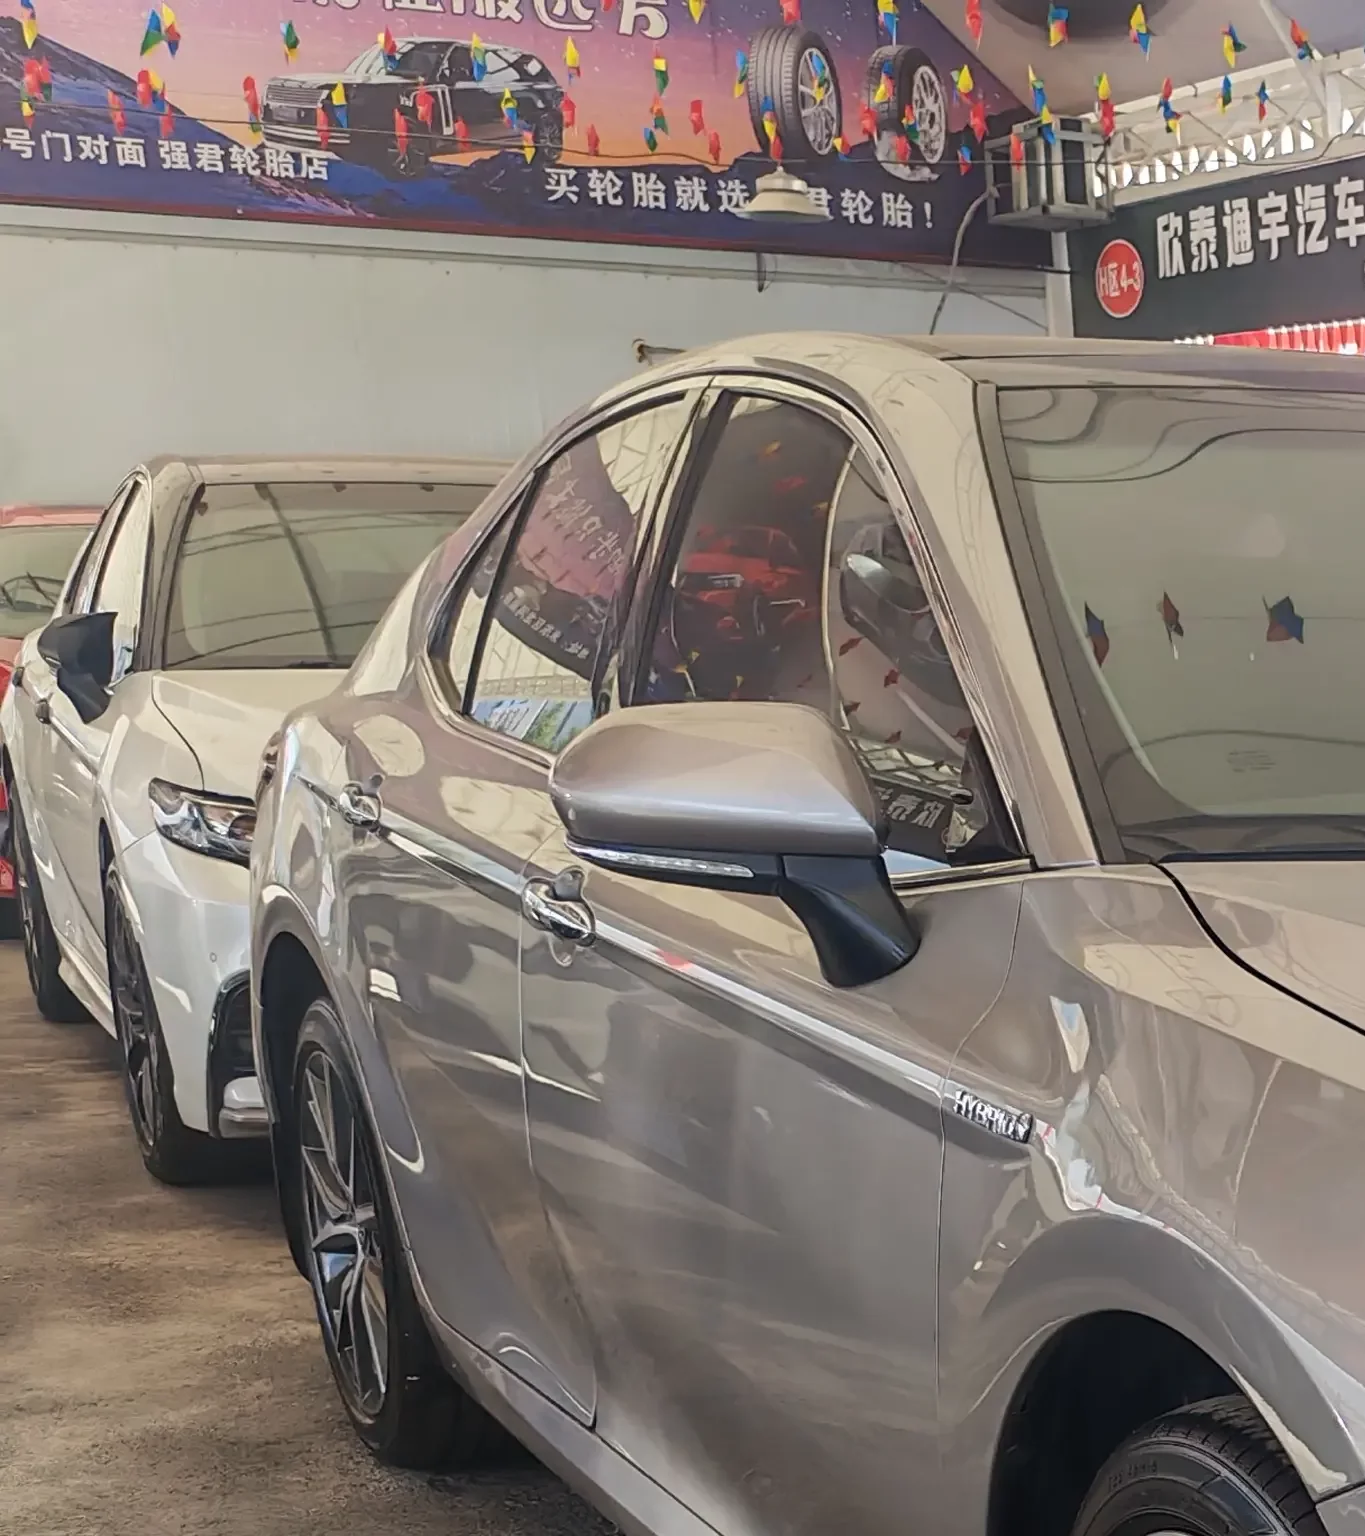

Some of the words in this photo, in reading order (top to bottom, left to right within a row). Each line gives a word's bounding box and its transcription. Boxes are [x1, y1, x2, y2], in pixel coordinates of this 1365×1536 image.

[1, 126, 147, 168] 号门对面
[157, 139, 329, 182] 强君轮胎店
[1097, 264, 1142, 300] H区4-3
